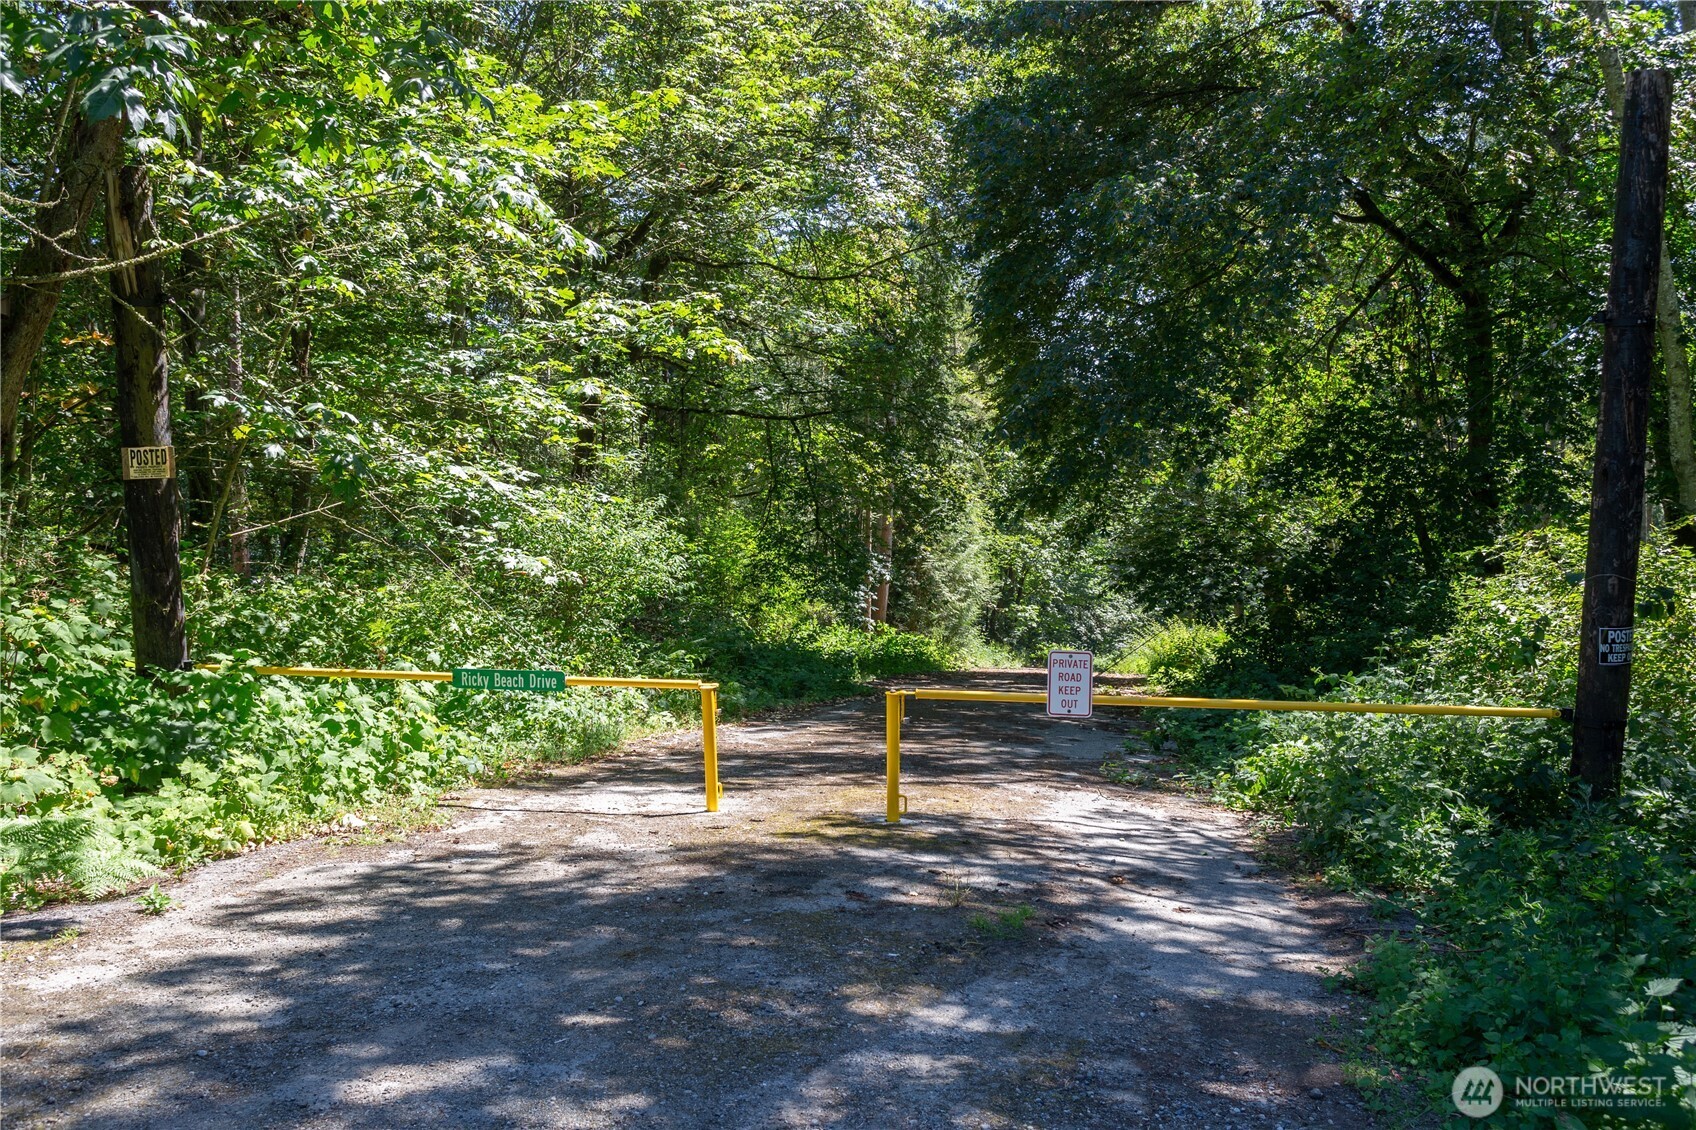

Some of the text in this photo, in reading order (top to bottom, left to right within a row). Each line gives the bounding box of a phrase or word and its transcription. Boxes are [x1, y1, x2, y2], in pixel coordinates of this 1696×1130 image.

[130, 449, 167, 468] POSTED
[1600, 643, 1610, 653] NO
[1052, 658, 1089, 669] PRIVATE
[1607, 653, 1626, 663] KEEP
[461, 671, 557, 690] Ricky Beach Drive
[1058, 672, 1082, 682] ROAD
[1058, 685, 1081, 696] KEEP
[1060, 698, 1079, 709] OUT
